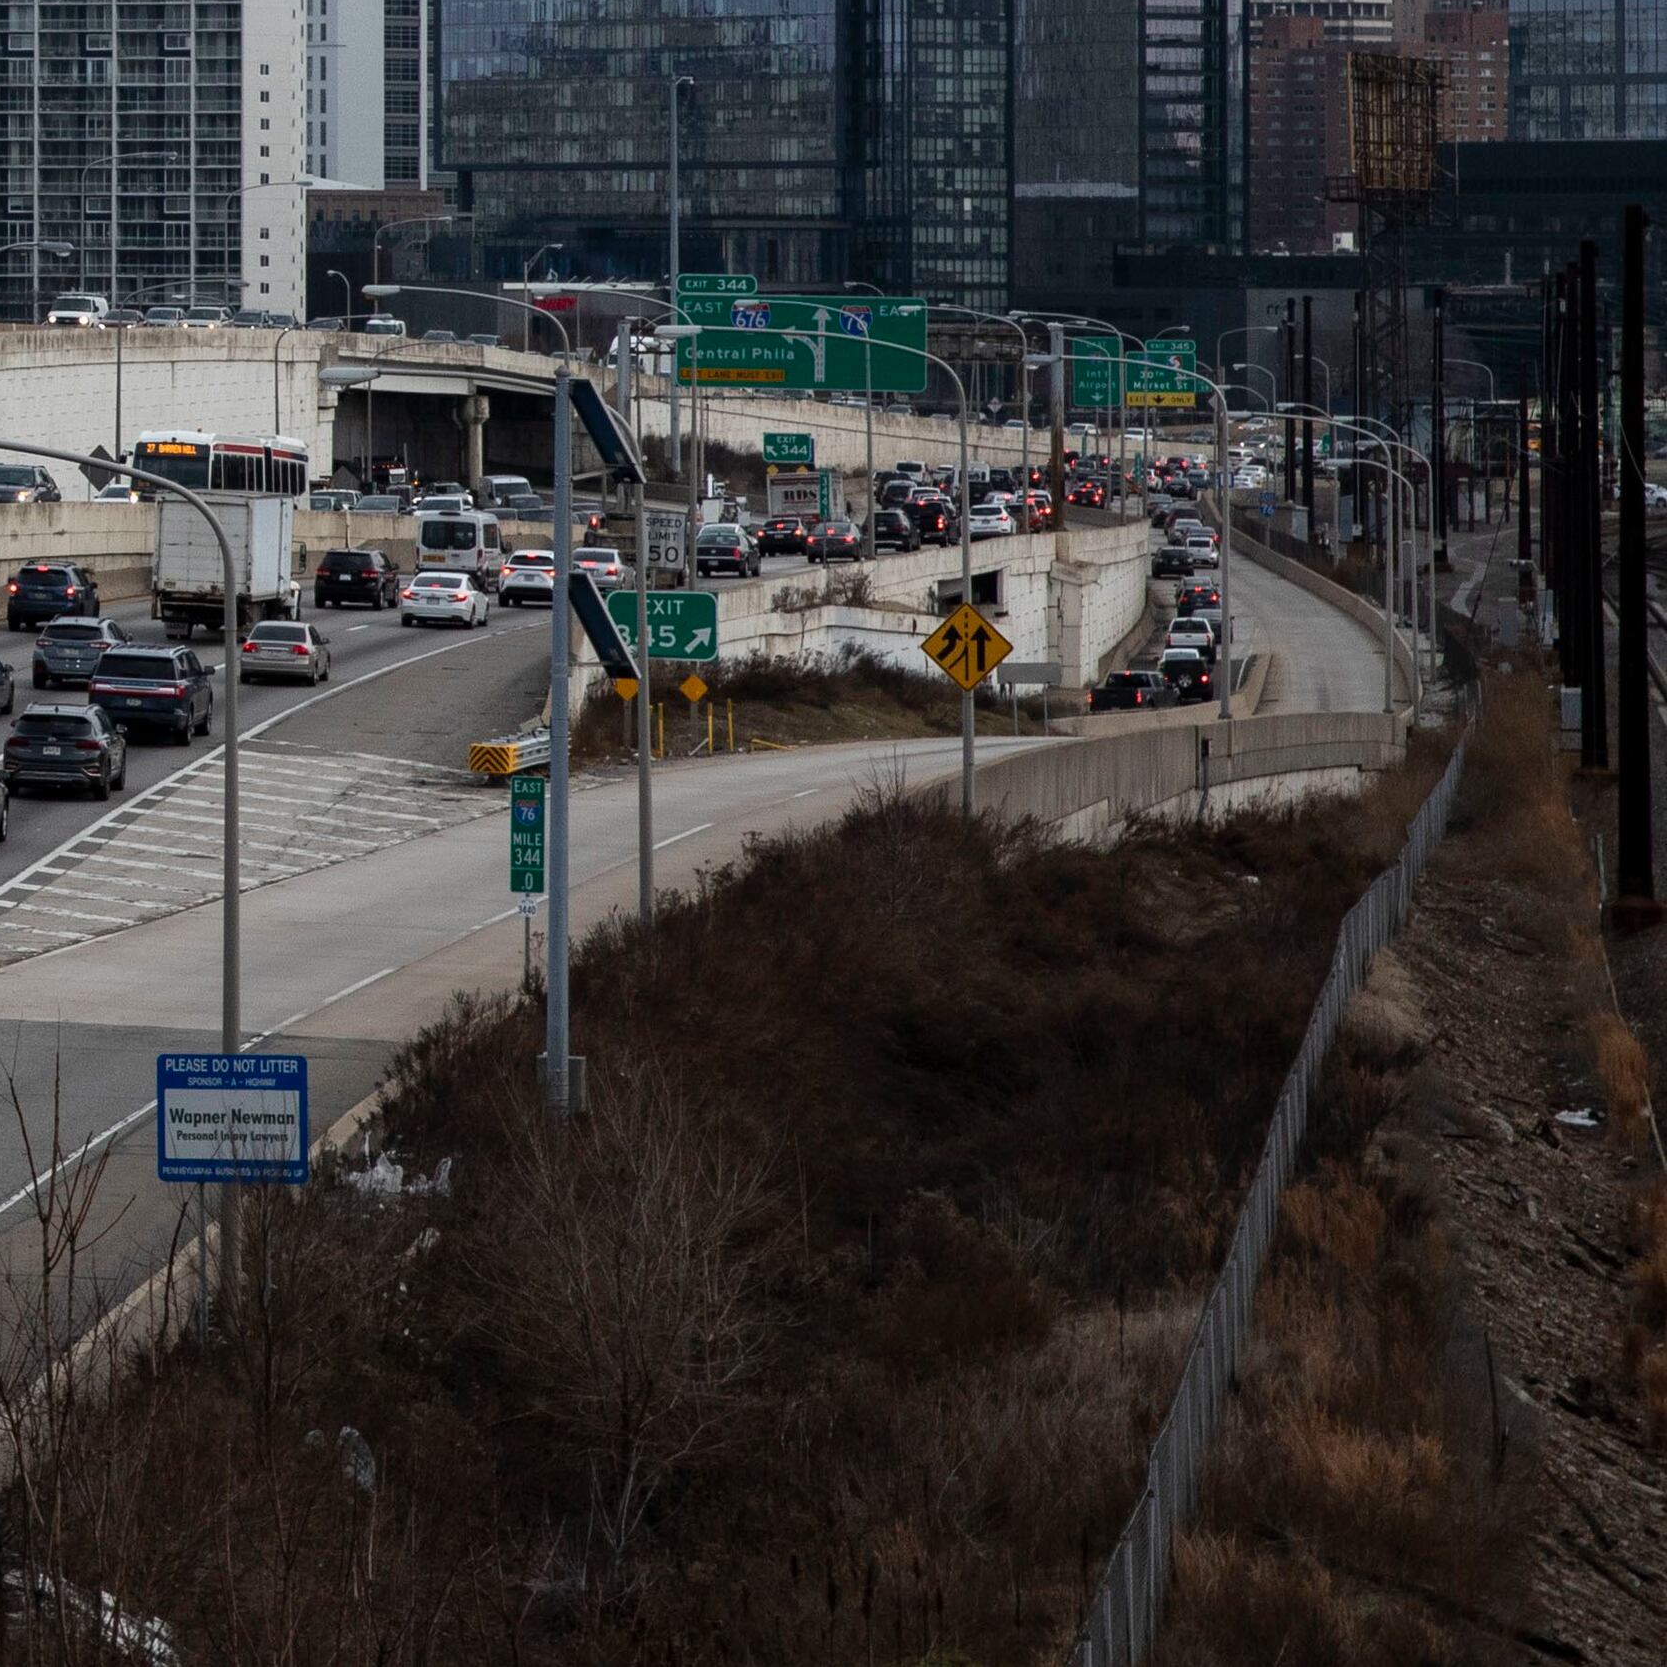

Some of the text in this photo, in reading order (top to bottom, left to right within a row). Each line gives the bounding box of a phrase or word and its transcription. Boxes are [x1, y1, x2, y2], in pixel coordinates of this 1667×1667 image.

[685, 279, 747, 291] EXIT 344
[684, 302, 767, 328] EAST 676
[845, 312, 866, 331] 76
[685, 348, 795, 360] Central Phila
[1079, 381, 1116, 389] Airpot
[781, 445, 807, 455] 344
[646, 517, 682, 528] SPEED
[649, 532, 677, 541] LIMIT
[649, 545, 679, 563] 50
[514, 780, 541, 793] EAST
[521, 808, 535, 821] 76
[513, 833, 542, 846] MILE
[515, 848, 540, 865] 344
[165, 1058, 298, 1073] PLEASE DO NOT LITTER
[187, 1078, 222, 1086] SPONSOR
[231, 1078, 237, 1086] A
[245, 1078, 276, 1087] HIGHWAY
[170, 1109, 295, 1127] Wapner Newman
[177, 1130, 217, 1141] Personal
[251, 1131, 288, 1143] Lawyers
[294, 1169, 304, 1177] UP
